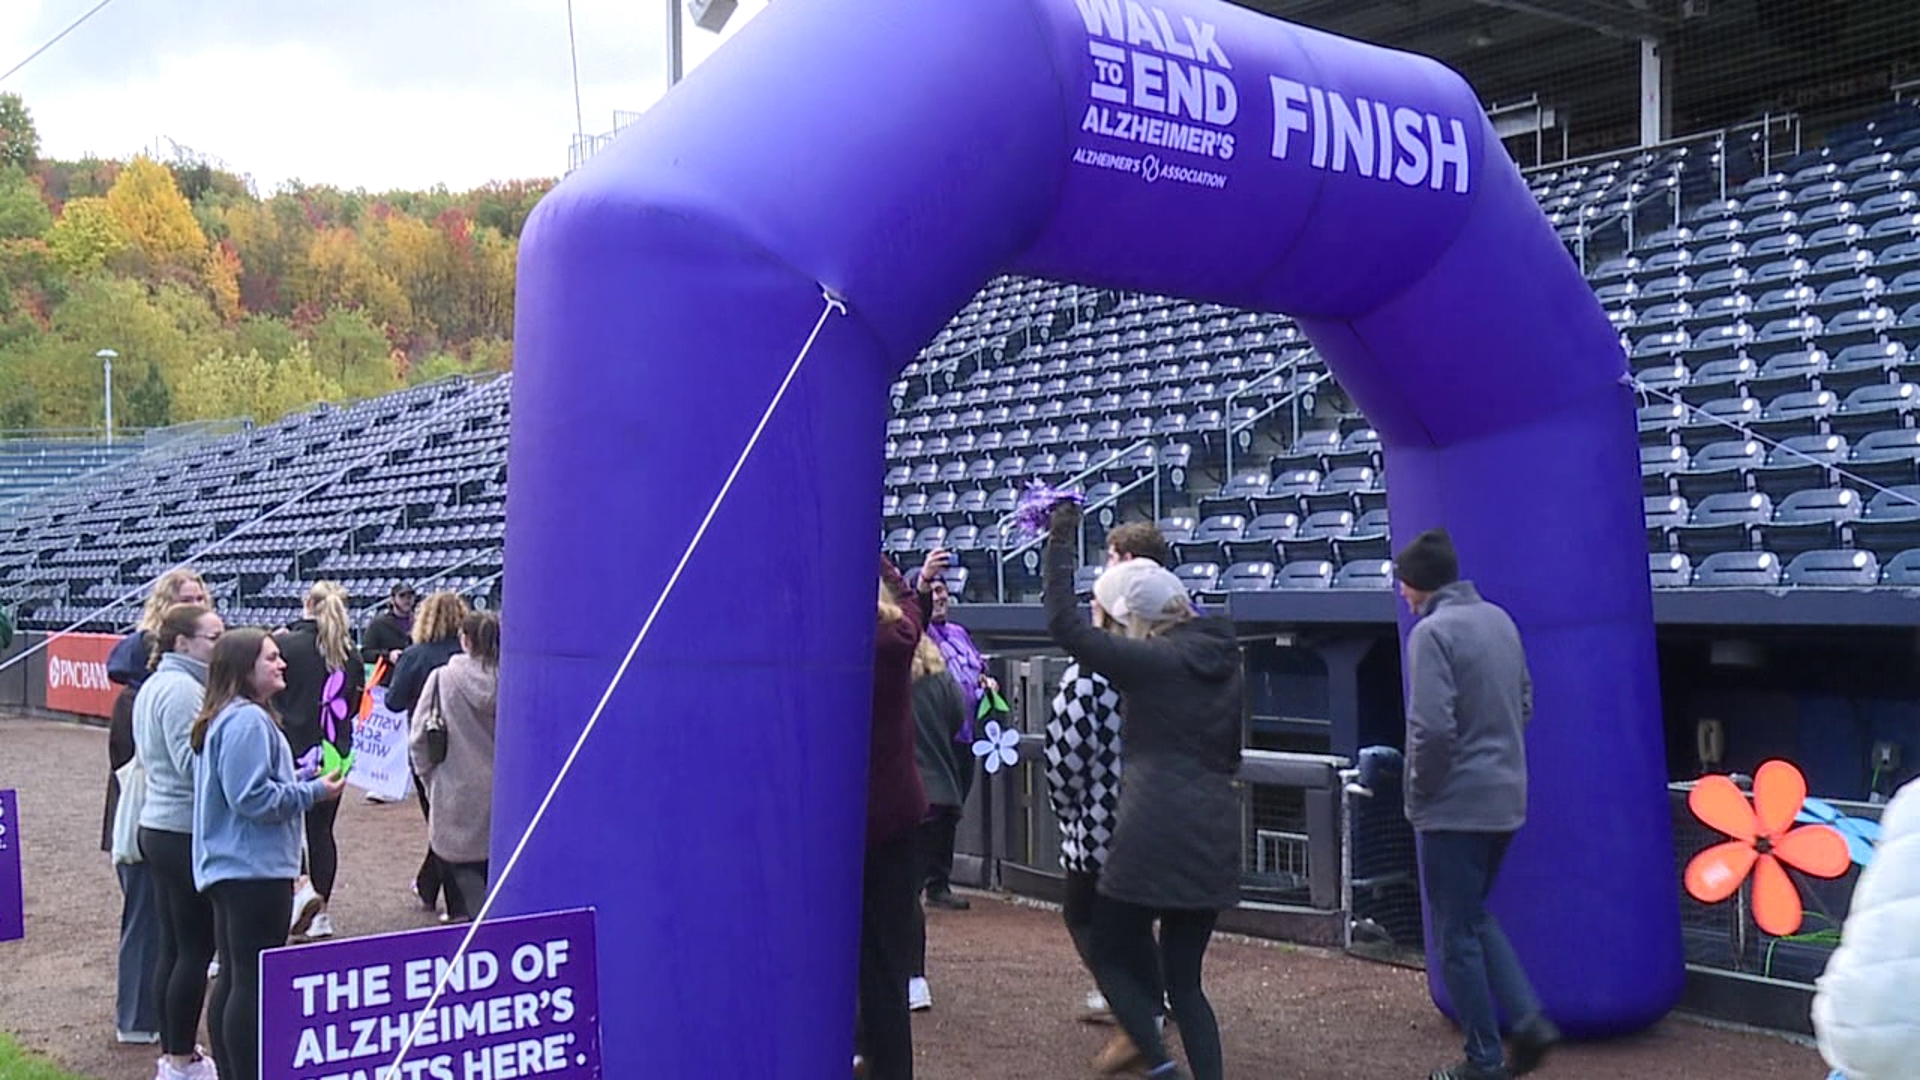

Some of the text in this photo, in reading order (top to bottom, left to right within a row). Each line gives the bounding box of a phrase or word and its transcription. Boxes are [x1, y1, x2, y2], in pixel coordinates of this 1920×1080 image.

[1074, 0, 1233, 70] WALK
[1094, 50, 1238, 126] TO END
[1073, 148, 1228, 189] ALZHEIMER'S ASSOCIATION
[1082, 104, 1236, 160] ALZHEIMER'S
[1269, 74, 1469, 194] FINISH
[292, 939, 569, 1017] THE END OF
[292, 987, 576, 1068] ALZHEIMER'S
